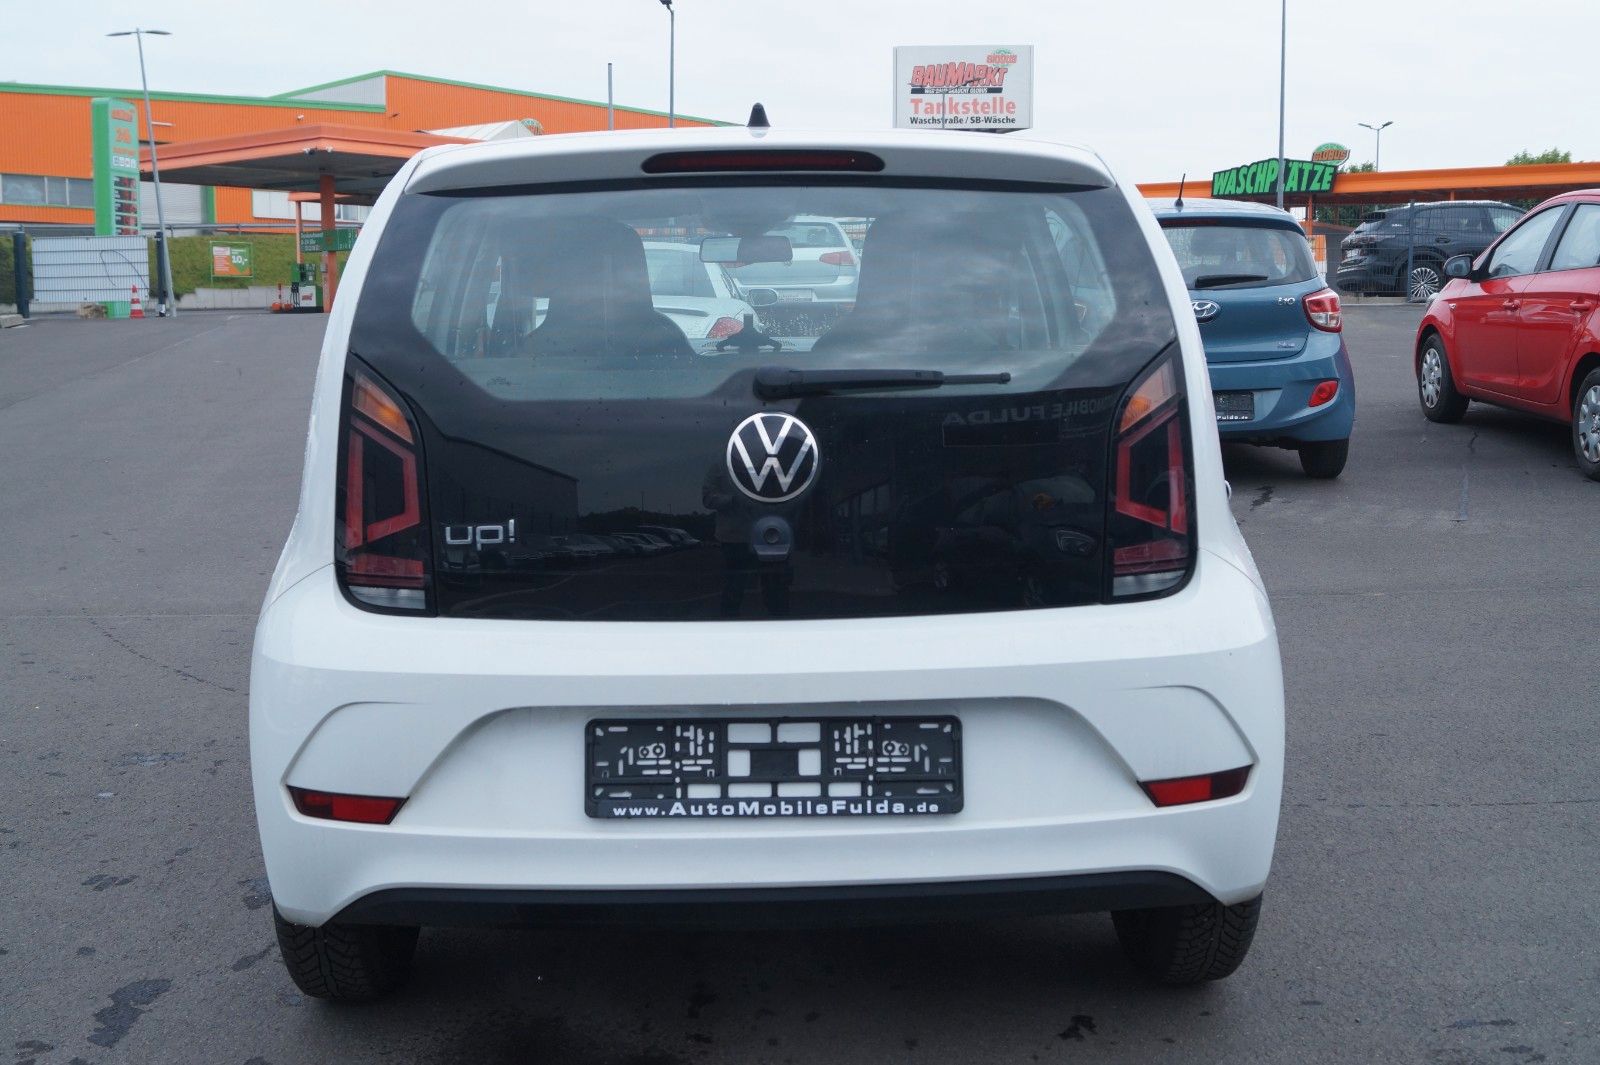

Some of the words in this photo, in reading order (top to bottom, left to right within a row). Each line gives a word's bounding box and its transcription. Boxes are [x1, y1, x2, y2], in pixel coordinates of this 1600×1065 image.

[910, 62, 1008, 87] BAUMARKT
[910, 96, 1016, 114] Tankstelle
[910, 116, 963, 124] Waschsraße
[970, 115, 1016, 124] SB-Wäsche
[1213, 160, 1335, 196] WASCHPÄTZE
[445, 519, 515, 551] up!
[613, 800, 939, 817] www.AutoMobileFulda.de
